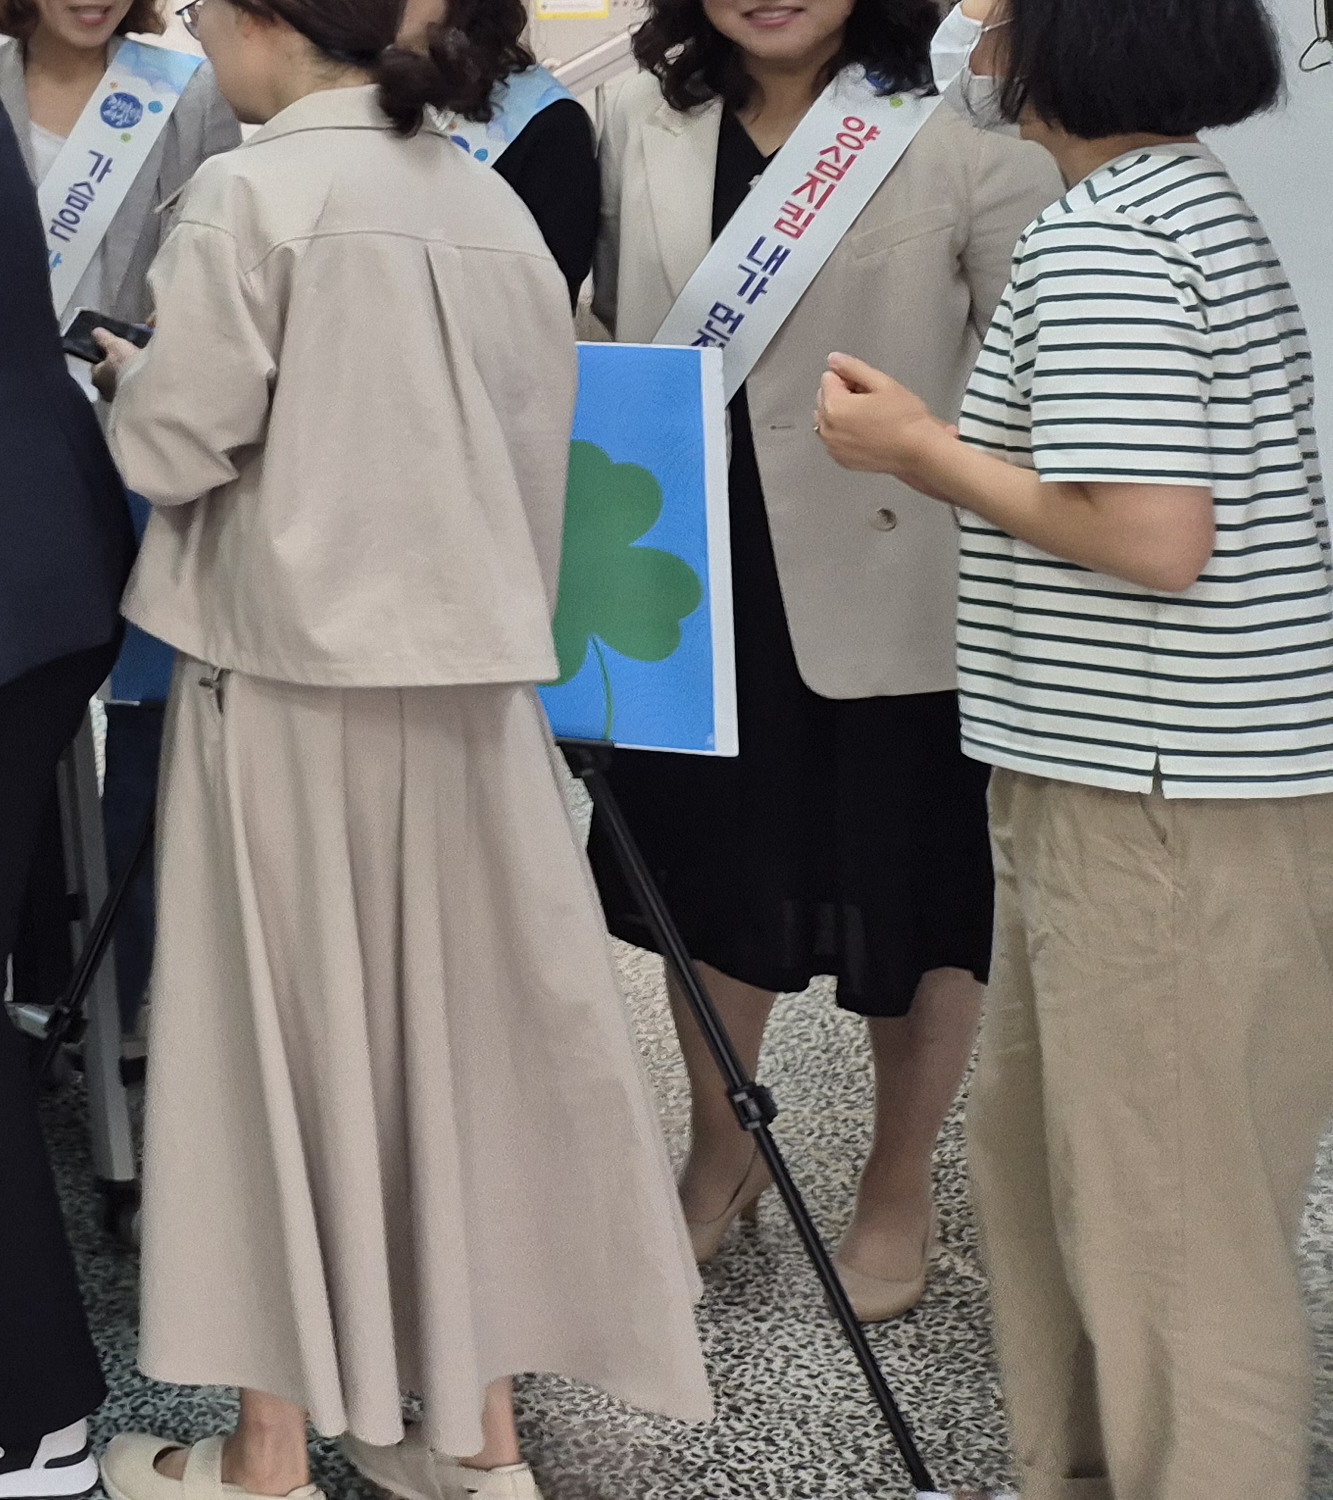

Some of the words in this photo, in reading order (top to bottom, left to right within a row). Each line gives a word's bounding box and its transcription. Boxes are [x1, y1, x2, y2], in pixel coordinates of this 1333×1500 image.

[49, 149, 113, 243] 가슴은
[773, 114, 883, 241] 양심지킴
[736, 235, 793, 306] 내가
